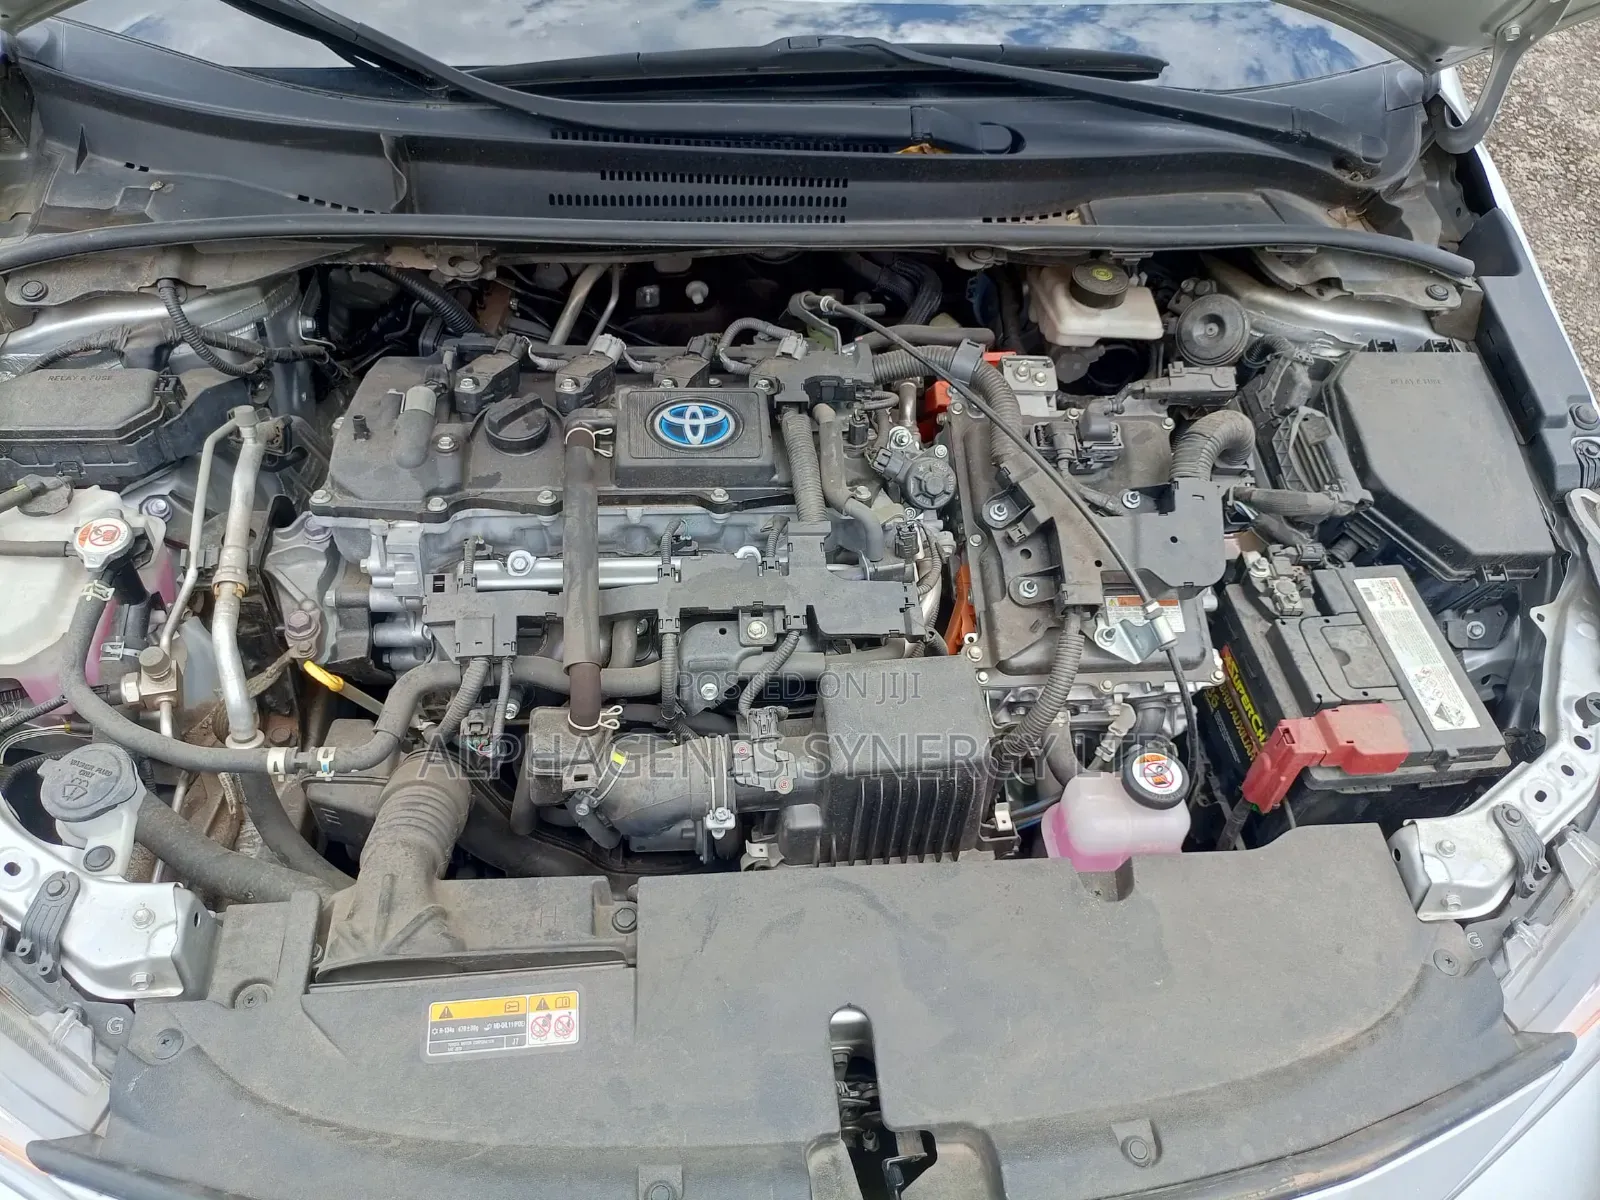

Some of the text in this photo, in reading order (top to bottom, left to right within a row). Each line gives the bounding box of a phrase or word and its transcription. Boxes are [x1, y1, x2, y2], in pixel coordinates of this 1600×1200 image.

[1230, 710, 1257, 761] AUXILIAR
[1466, 931, 1484, 949] G
[106, 1016, 124, 1035] G
